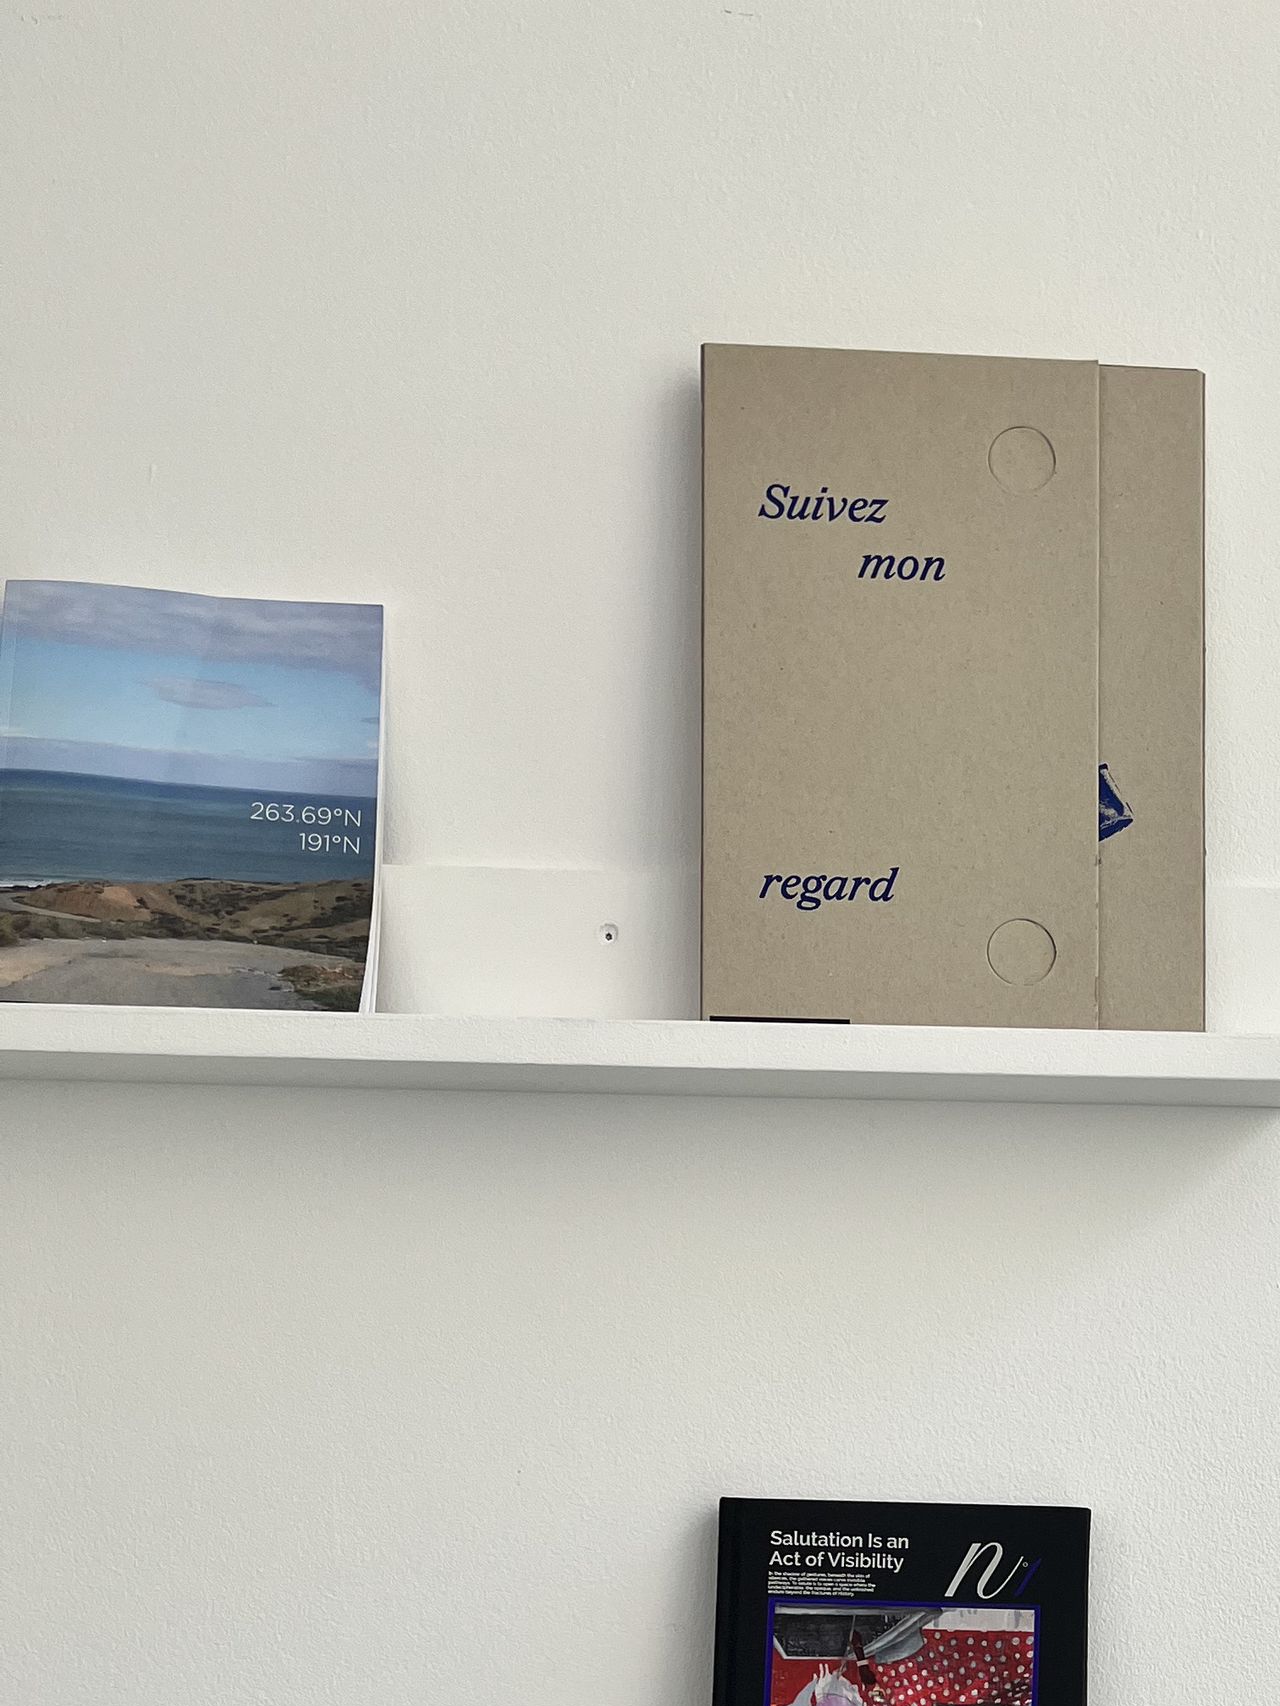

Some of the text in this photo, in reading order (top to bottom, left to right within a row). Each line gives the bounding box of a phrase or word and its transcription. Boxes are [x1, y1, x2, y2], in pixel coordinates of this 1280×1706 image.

[758, 483, 889, 524] Suivez
[858, 554, 946, 582] mon
[250, 802, 362, 828] 263.69°N
[299, 832, 360, 855] 191°N
[758, 866, 899, 911] regard
[770, 1530, 909, 1549] Salutation Is an
[769, 1551, 904, 1573] Act of Visibility
